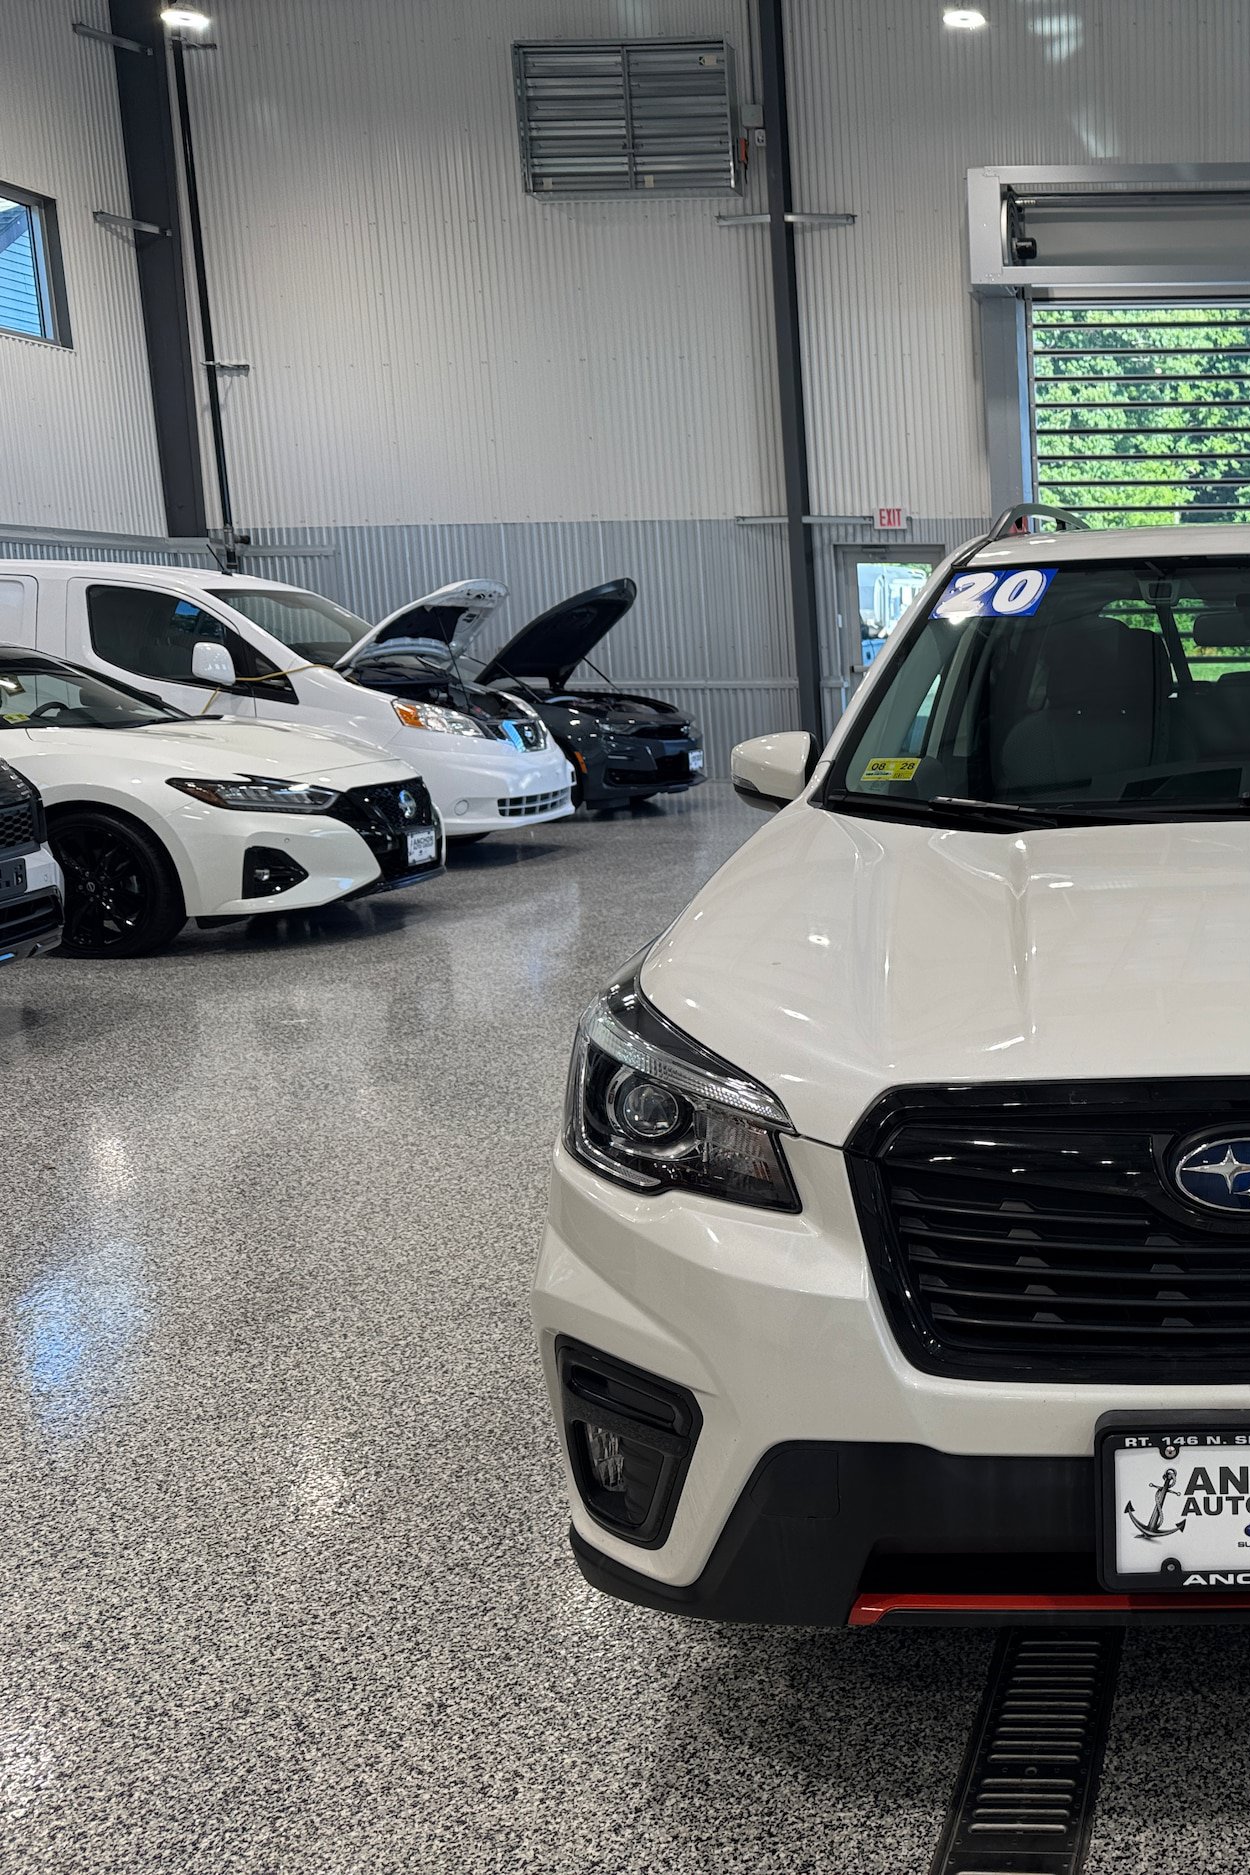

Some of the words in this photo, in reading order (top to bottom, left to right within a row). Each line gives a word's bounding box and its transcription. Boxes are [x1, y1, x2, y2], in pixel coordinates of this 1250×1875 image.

[879, 508, 902, 527] EXIT
[936, 569, 1047, 615] 20
[1124, 1436, 1153, 1448] RT.
[1161, 1436, 1199, 1446] 146
[1206, 1435, 1227, 1445] N.
